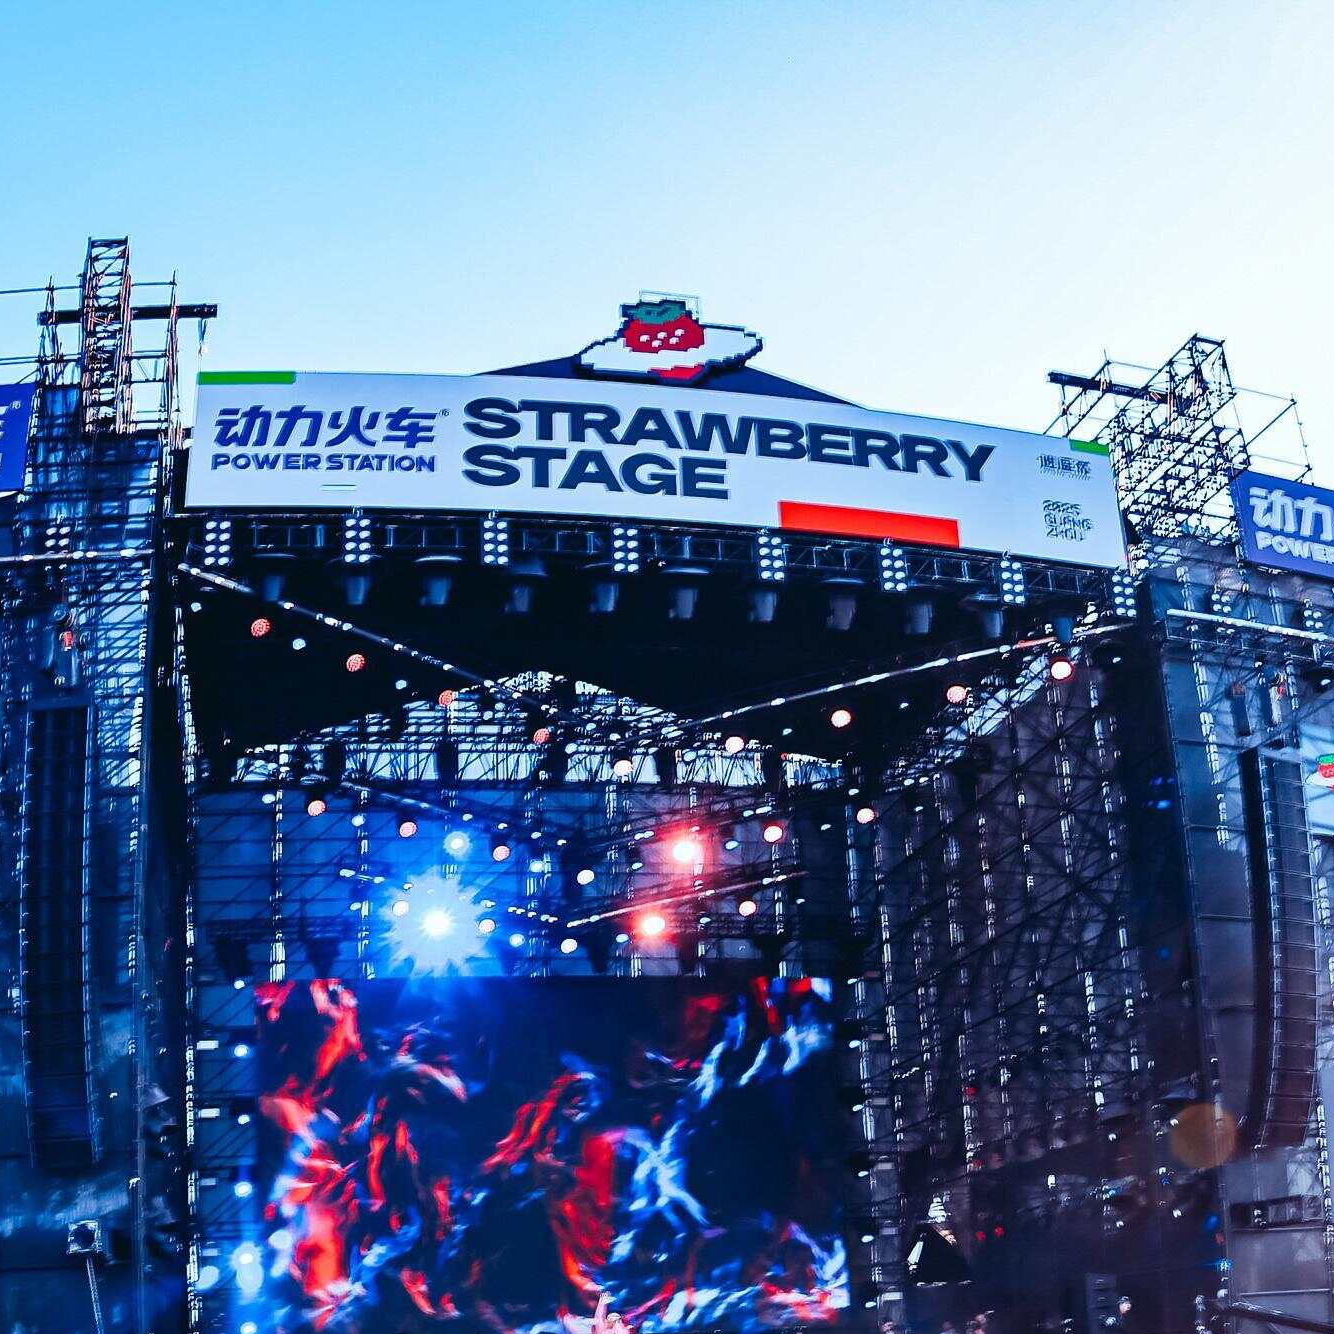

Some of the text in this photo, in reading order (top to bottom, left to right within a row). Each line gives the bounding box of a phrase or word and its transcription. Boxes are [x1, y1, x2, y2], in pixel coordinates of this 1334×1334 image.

[212, 405, 440, 449] 动力火车
[462, 397, 997, 482] STRAWBERRY
[461, 444, 730, 500] STAGE
